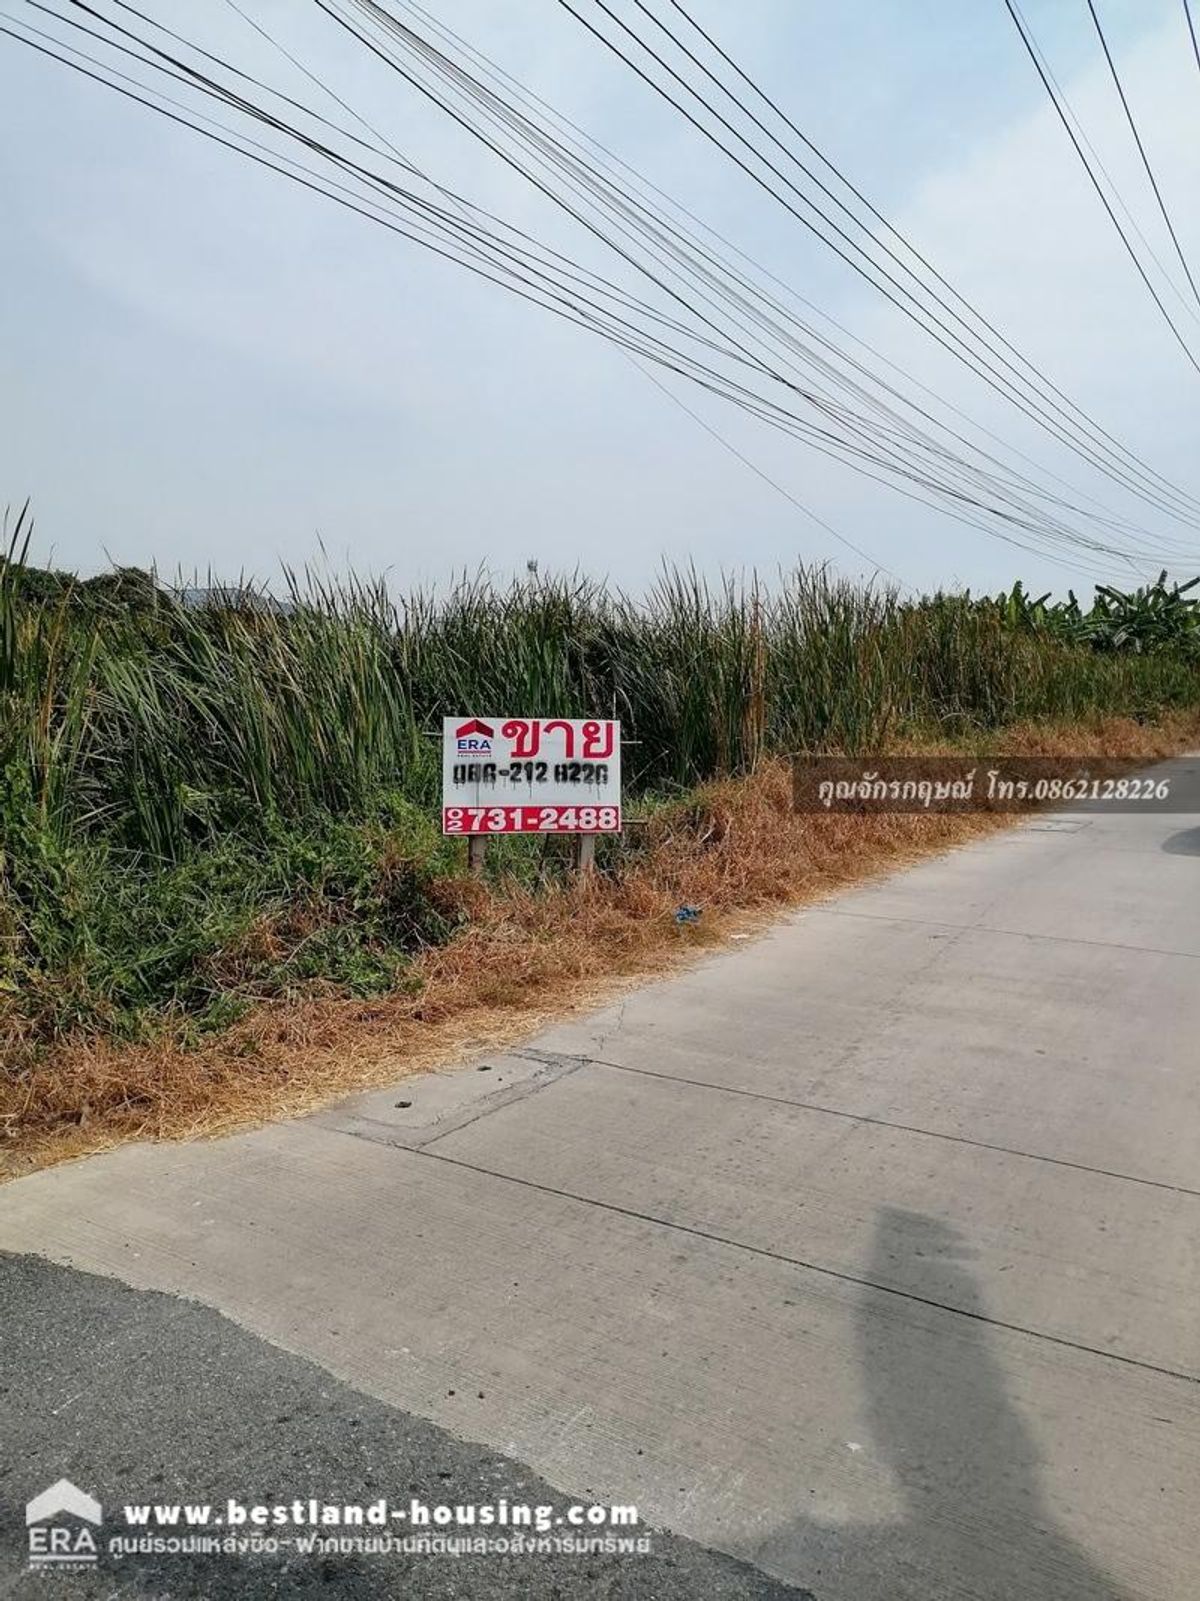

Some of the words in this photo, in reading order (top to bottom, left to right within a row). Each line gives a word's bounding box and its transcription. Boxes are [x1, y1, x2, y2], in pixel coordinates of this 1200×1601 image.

[457, 739, 492, 750] ERA
[501, 720, 614, 758] ขาย
[467, 808, 618, 831] 731-2488
